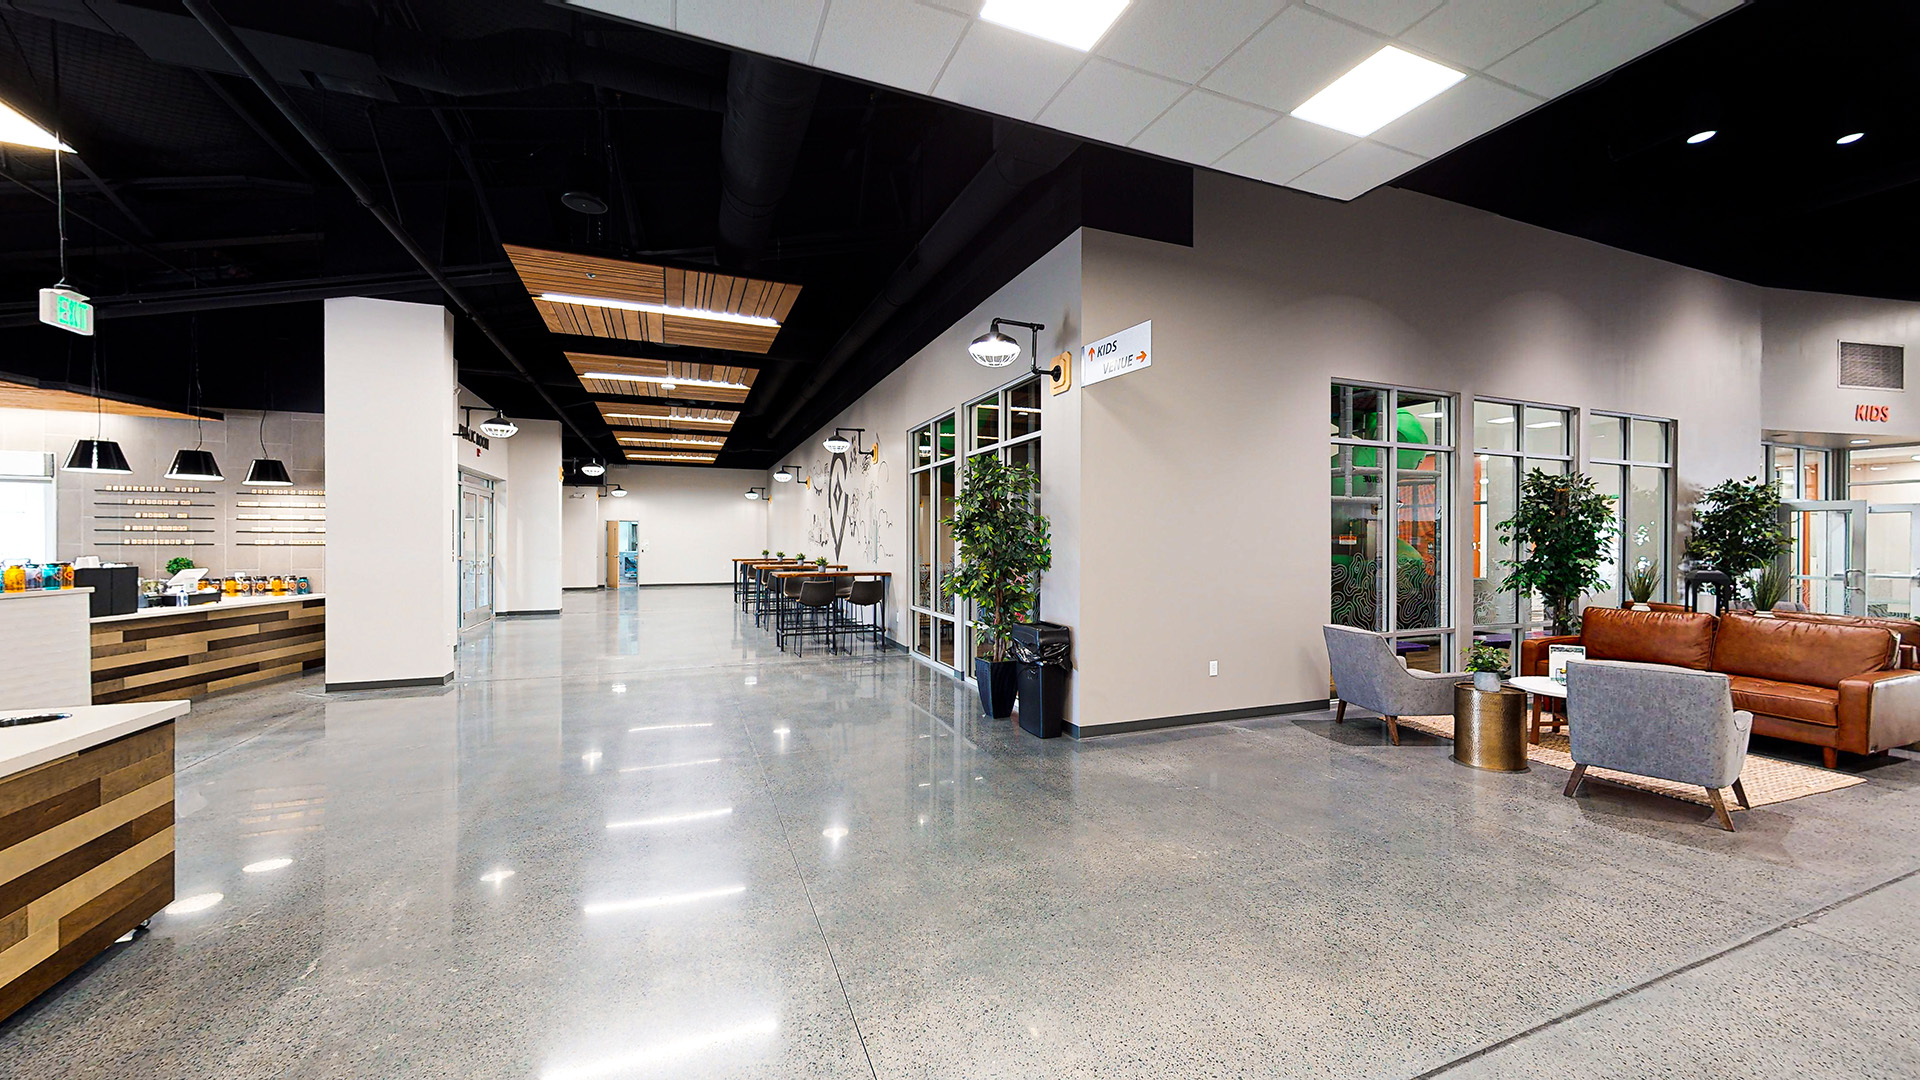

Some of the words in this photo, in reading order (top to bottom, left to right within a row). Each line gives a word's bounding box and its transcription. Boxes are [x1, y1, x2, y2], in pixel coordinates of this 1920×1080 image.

[58, 295, 88, 331] EXIT
[1097, 340, 1117, 358] KIDS
[1103, 354, 1134, 375] VENUE
[1855, 404, 1889, 422] KIDS
